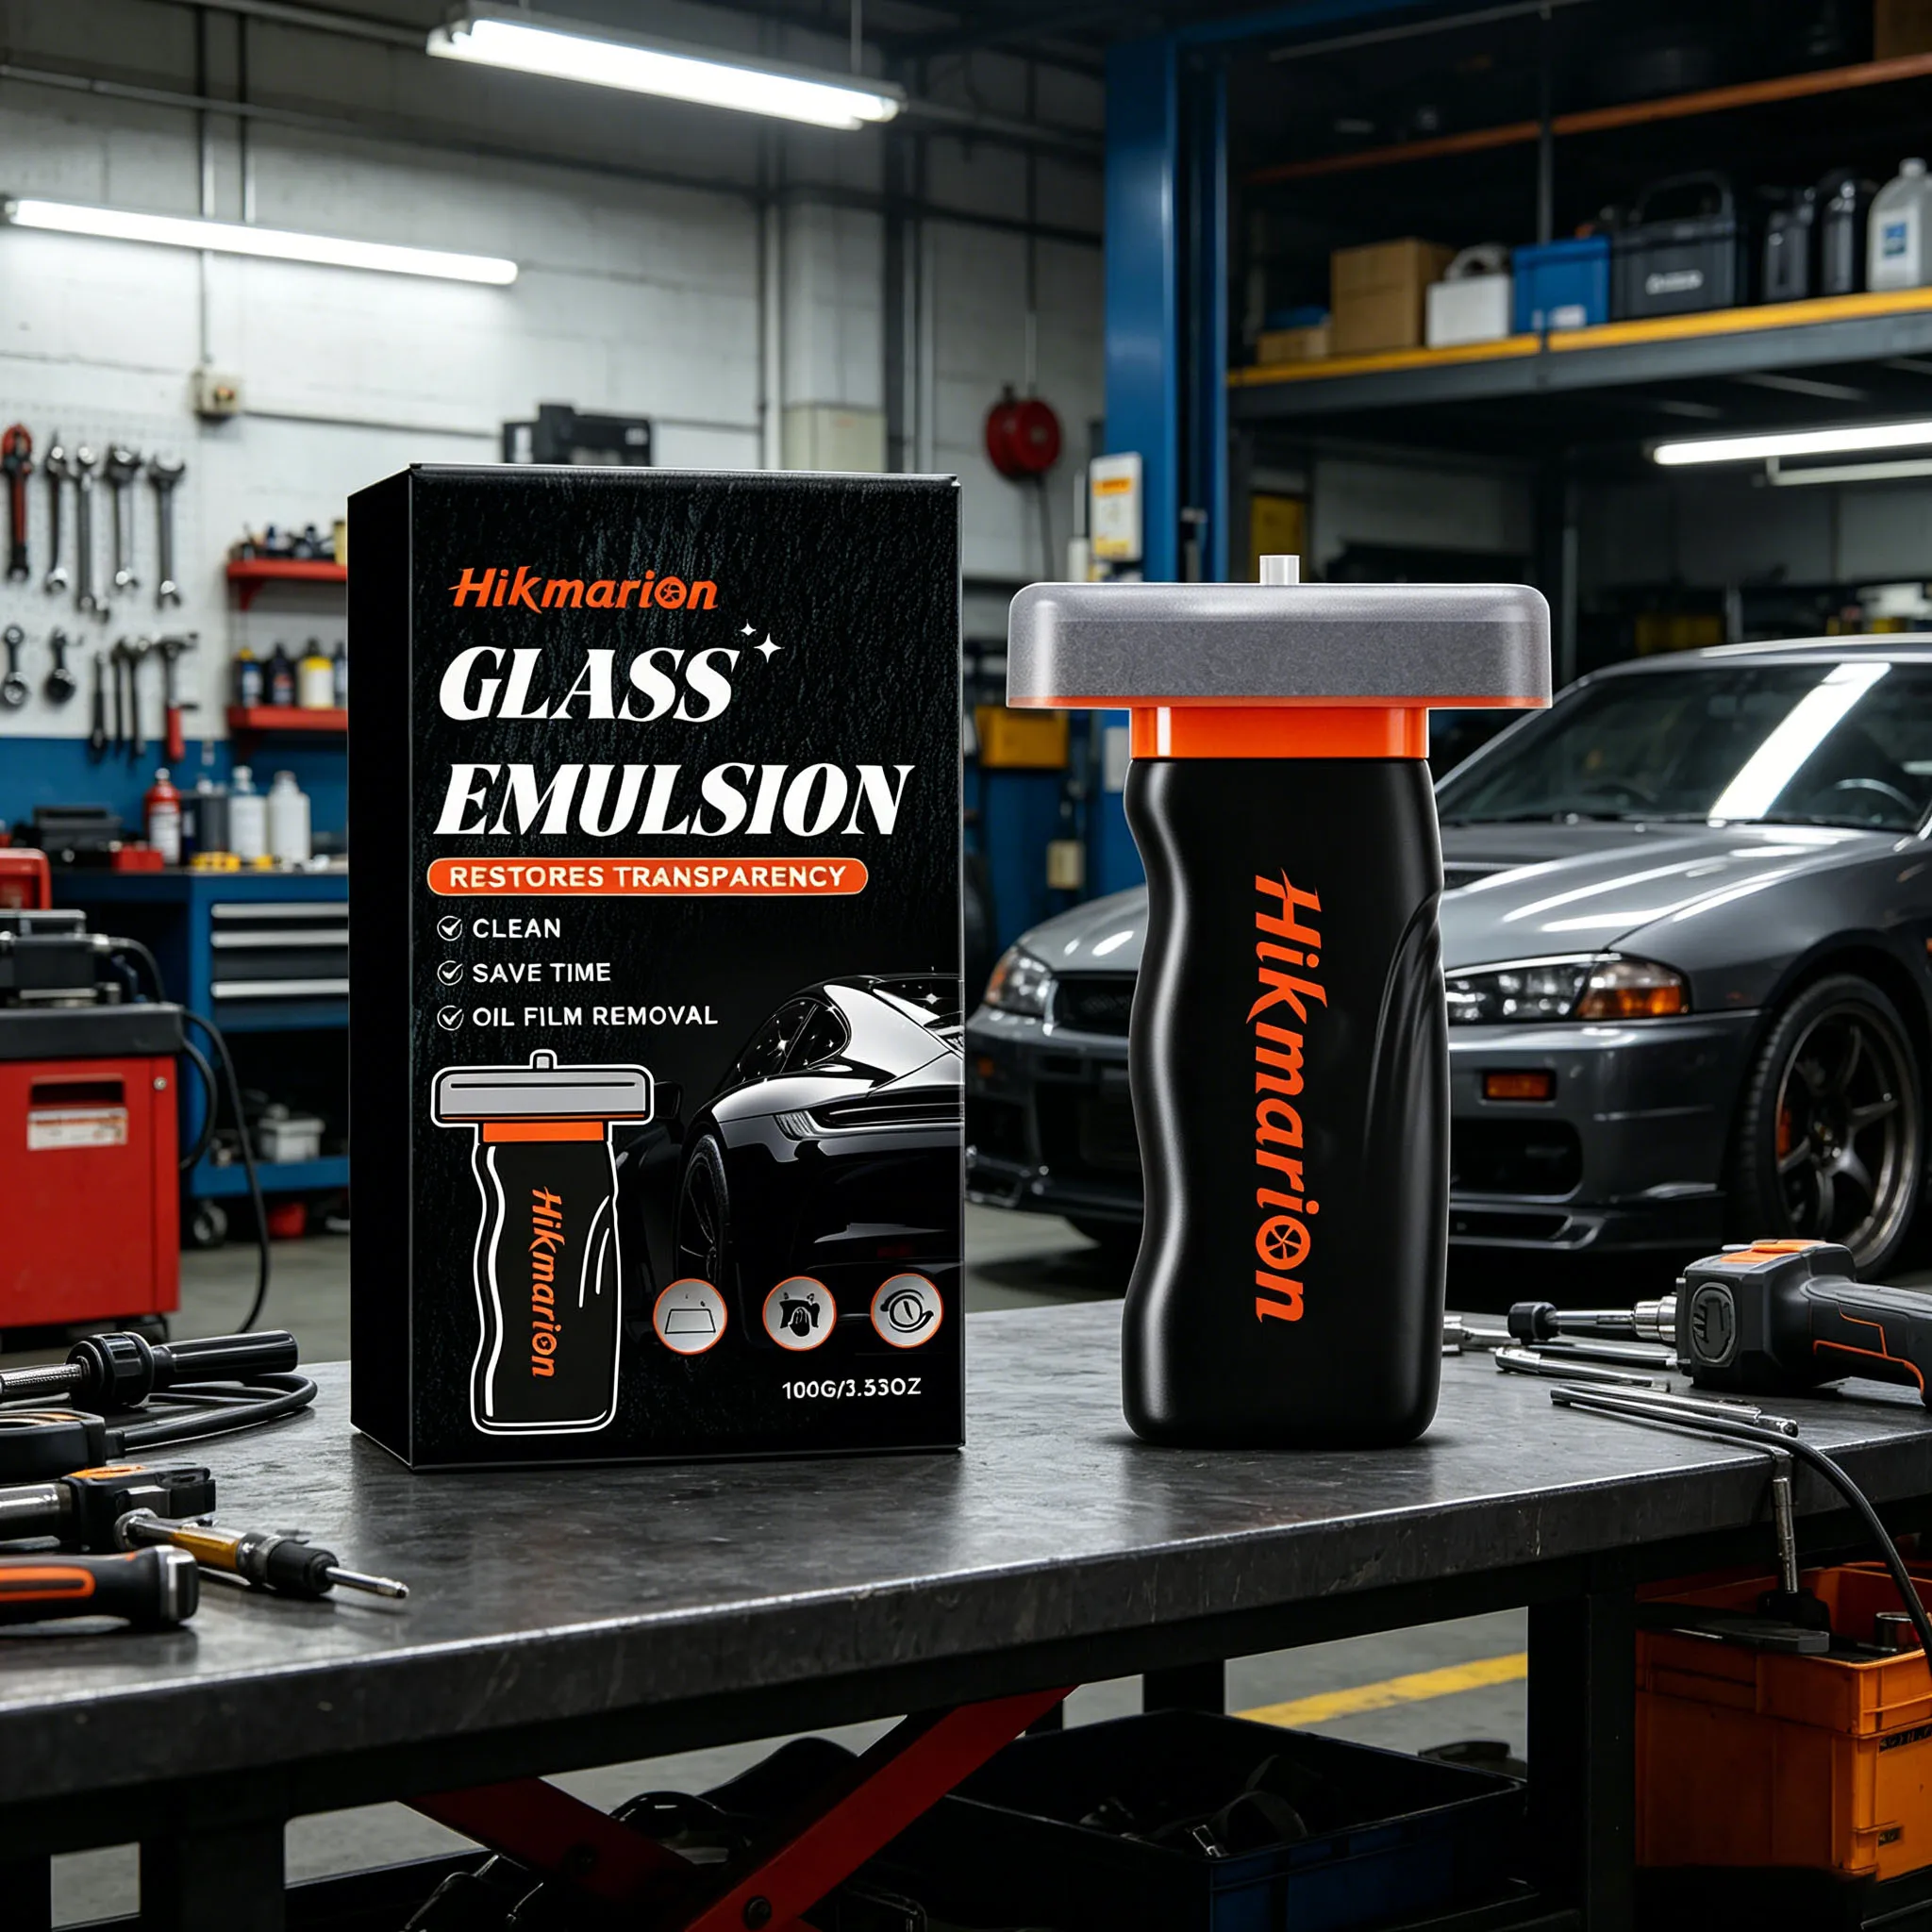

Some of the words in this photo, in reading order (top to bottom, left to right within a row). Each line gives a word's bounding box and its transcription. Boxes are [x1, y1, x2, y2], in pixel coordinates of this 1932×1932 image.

[449, 566, 719, 614] Hikmarion
[439, 646, 741, 724] GLASS
[433, 763, 916, 838] EMULSION
[450, 866, 605, 890] RESTORES
[613, 866, 847, 890] TRANSPARENCY
[473, 918, 562, 940] CLEAN
[473, 963, 543, 985] SAVE
[550, 963, 612, 984] TIME
[473, 1007, 516, 1028] OIL
[525, 1007, 583, 1028] FILM
[593, 1006, 720, 1027] REMOVAL
[1246, 869, 1328, 1324] Hikmarion
[530, 1186, 567, 1378] Hikmarion
